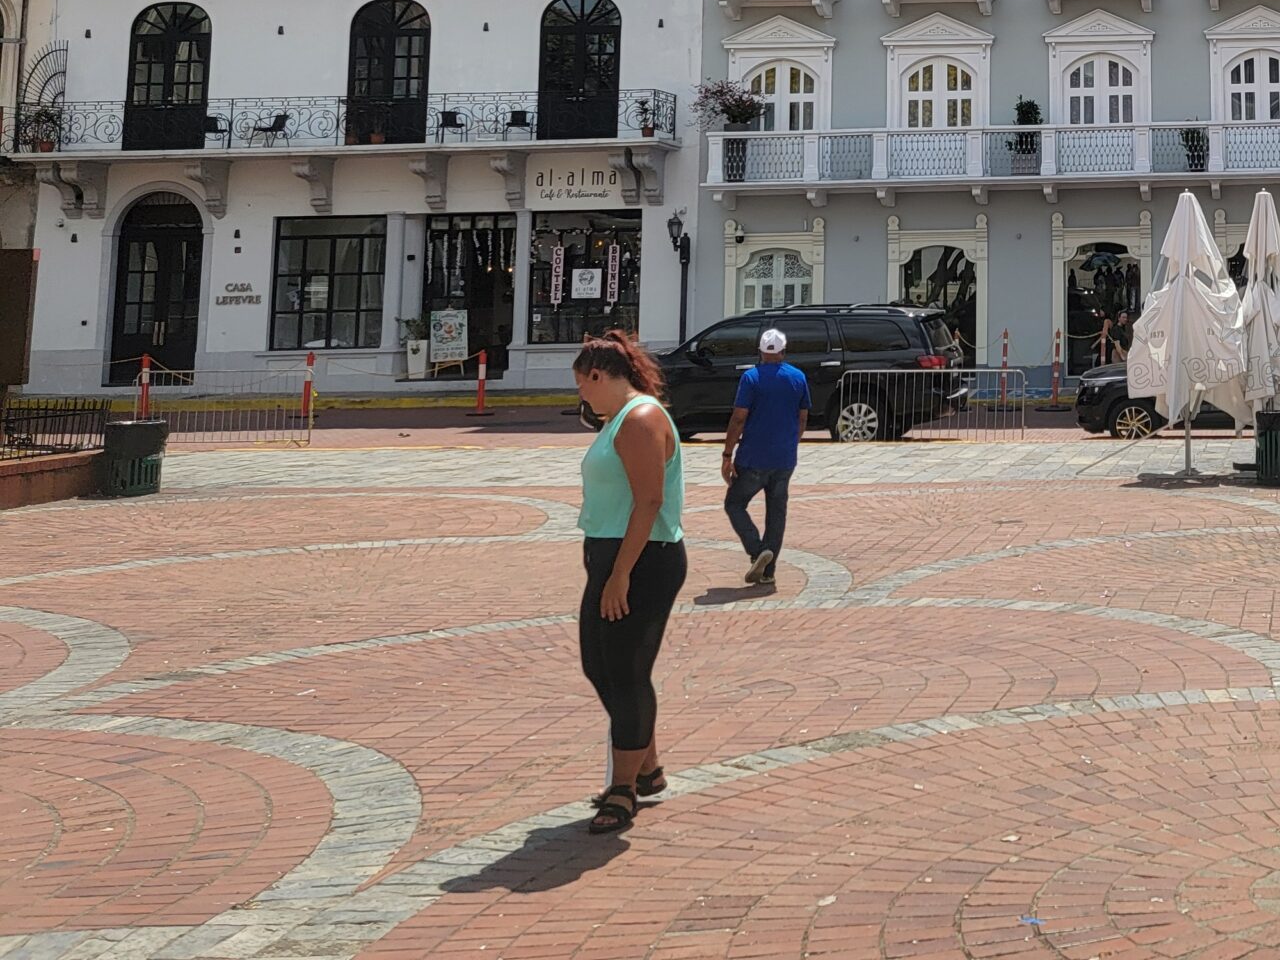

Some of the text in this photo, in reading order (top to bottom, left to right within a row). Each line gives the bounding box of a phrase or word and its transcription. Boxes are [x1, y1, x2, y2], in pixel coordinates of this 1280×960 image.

[565, 189, 612, 199] Restaurante
[553, 248, 562, 301] COCTEL
[609, 246, 618, 300] BRUNCH
[225, 283, 253, 293] CASA
[215, 295, 262, 306] LEFEVRE
